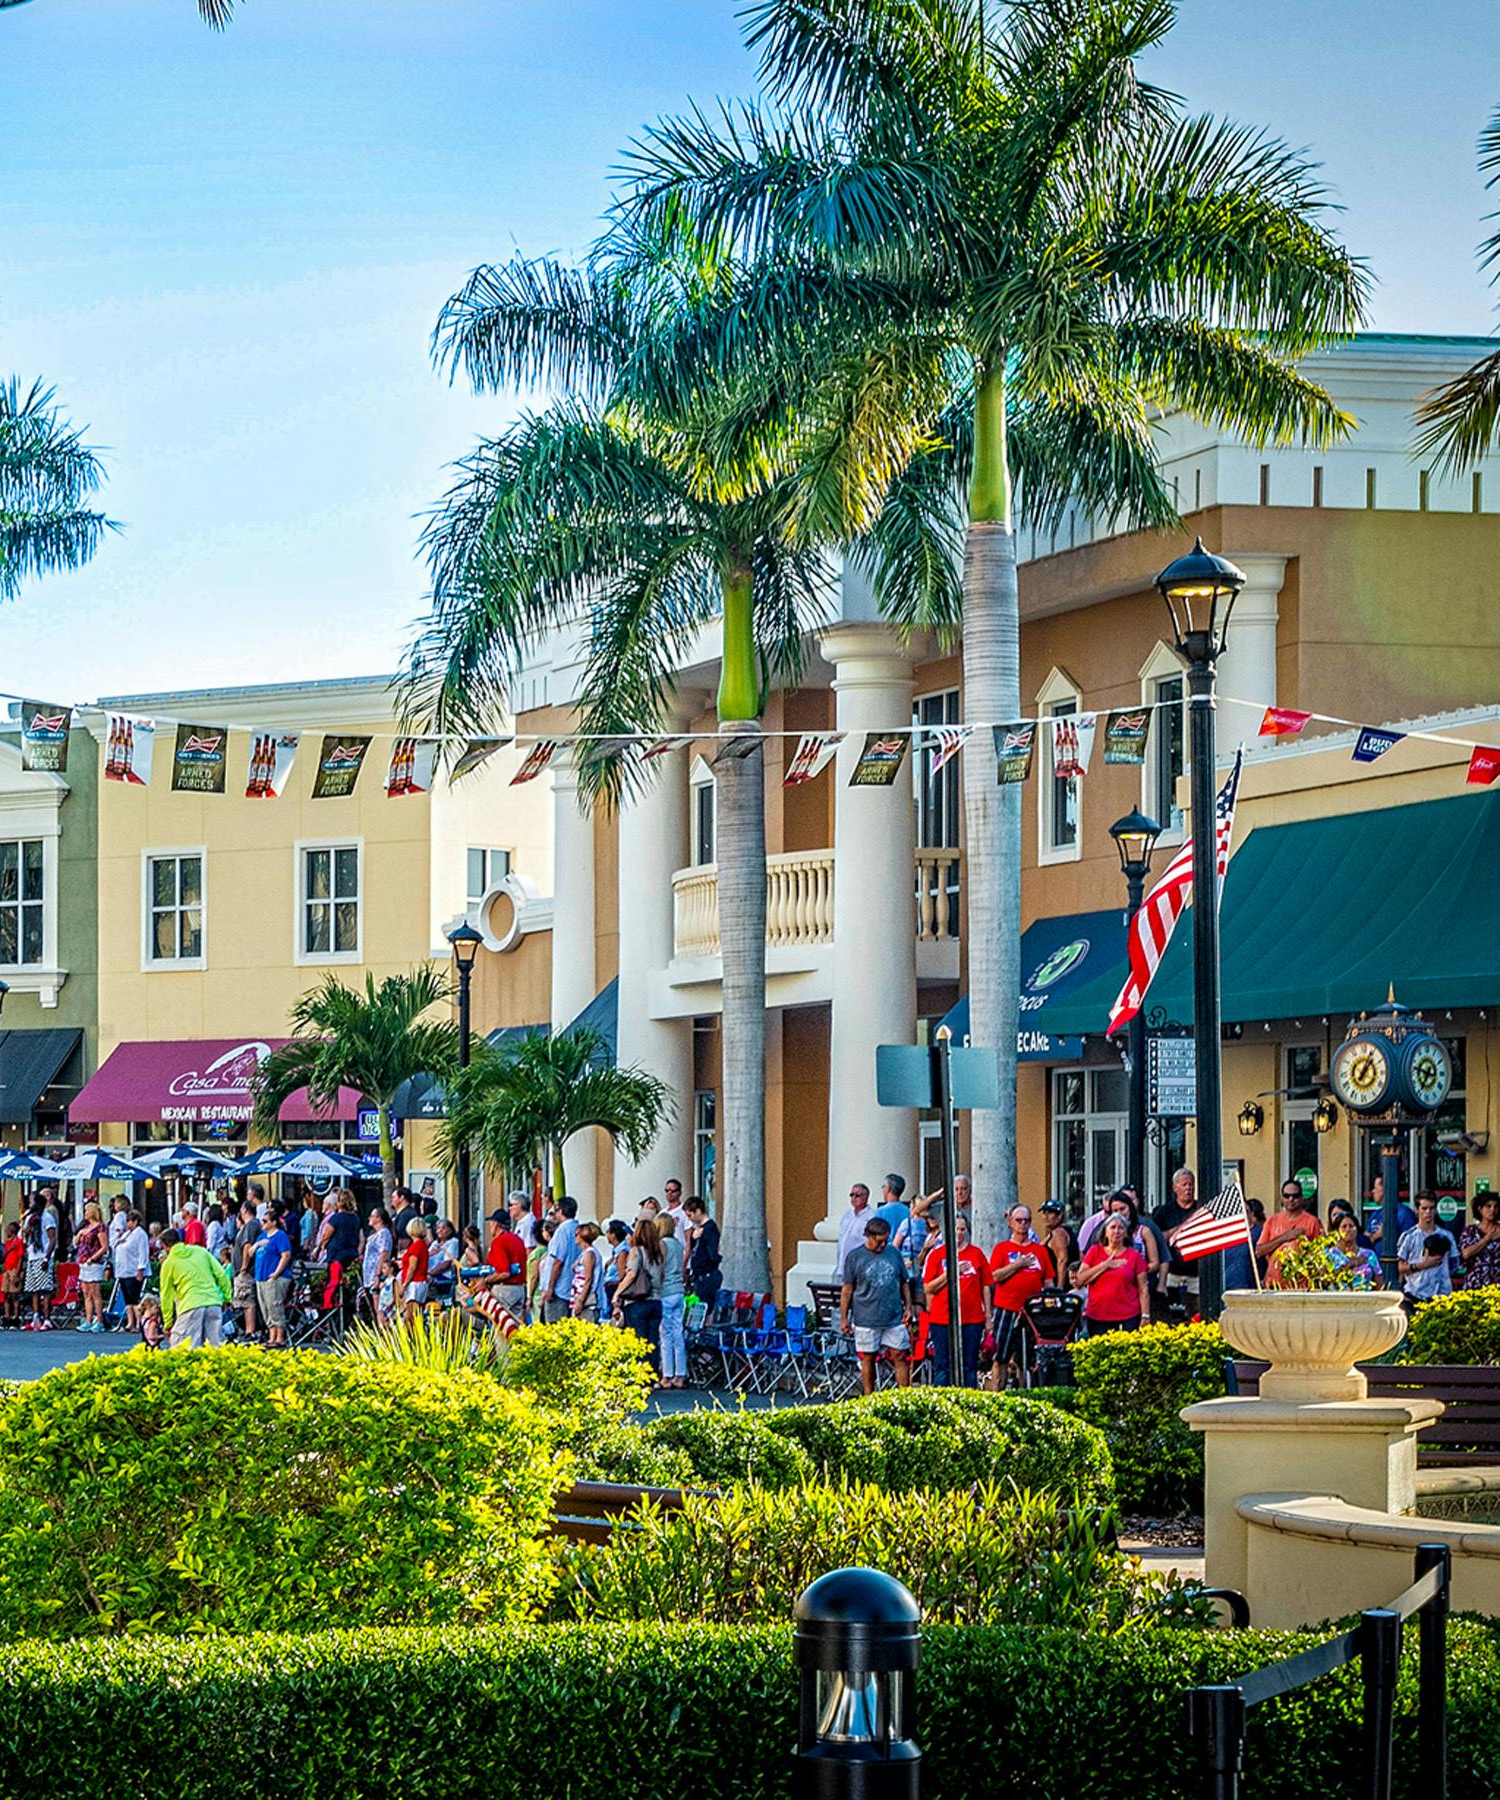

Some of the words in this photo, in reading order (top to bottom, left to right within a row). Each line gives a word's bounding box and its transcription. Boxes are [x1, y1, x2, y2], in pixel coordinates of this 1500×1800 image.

[1017, 1031, 1050, 1052] ECARE
[161, 1106, 197, 1120] MEXICAN
[201, 1105, 254, 1119] RESTAURANT
